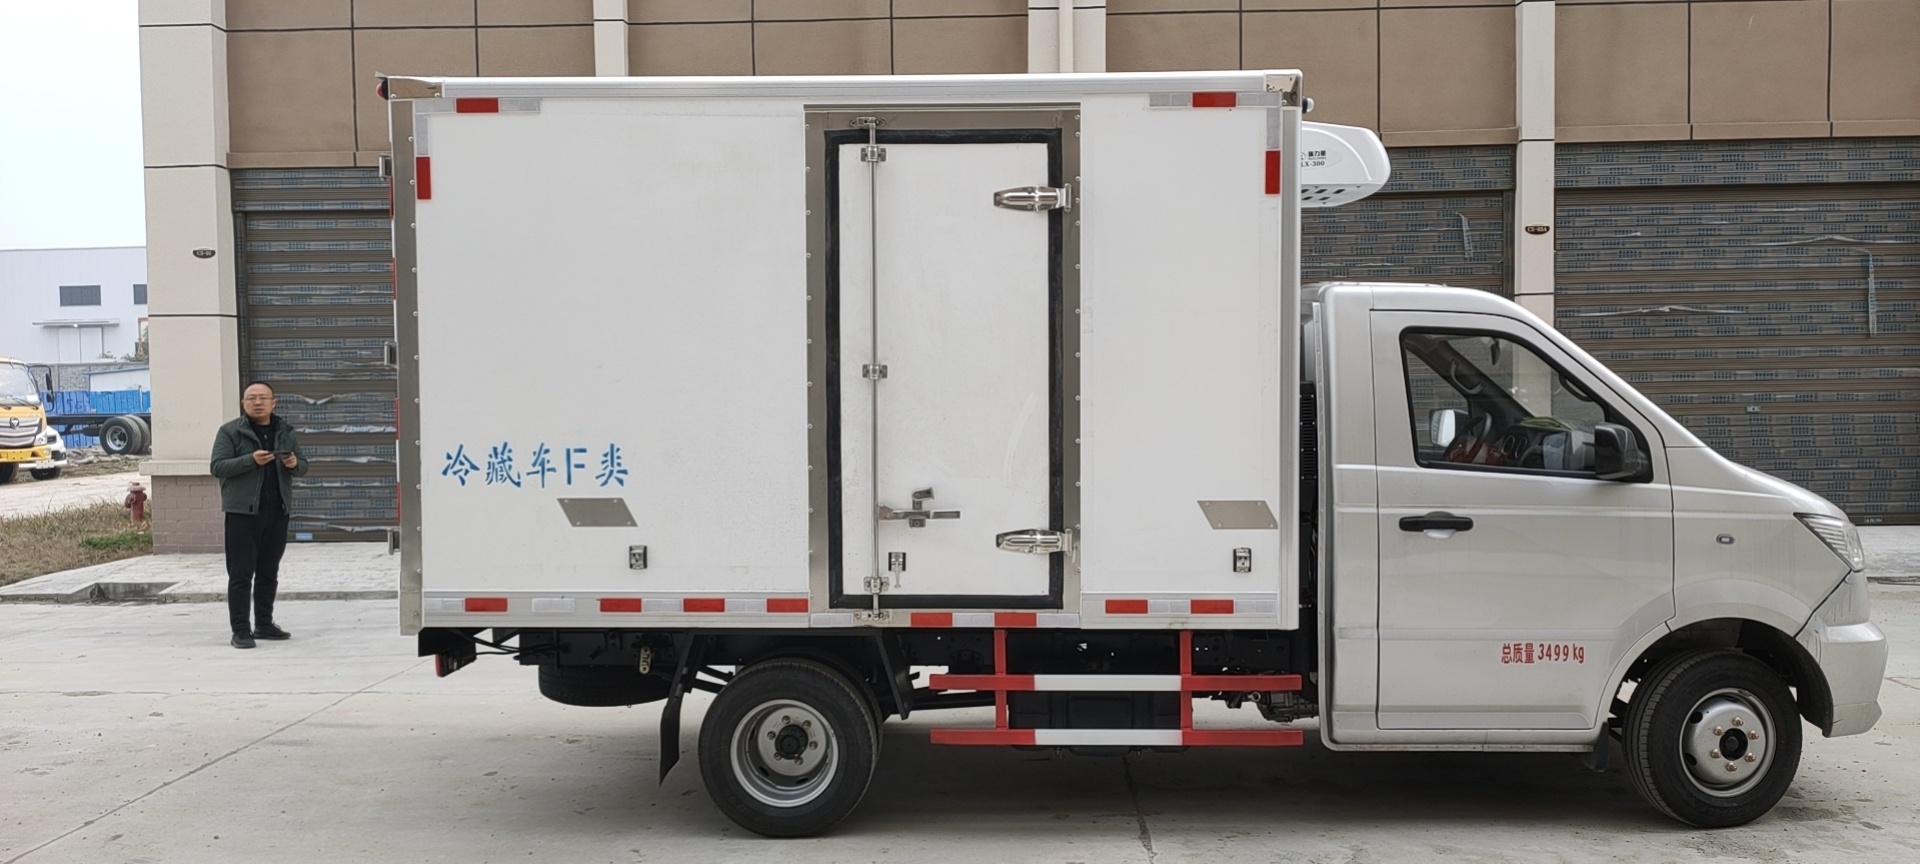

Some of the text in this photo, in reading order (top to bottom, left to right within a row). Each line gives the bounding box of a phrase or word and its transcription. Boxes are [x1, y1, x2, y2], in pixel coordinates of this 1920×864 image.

[441, 441, 629, 489] 冷藏车F类
[1501, 642, 1585, 664] 总质量 3499 kg
